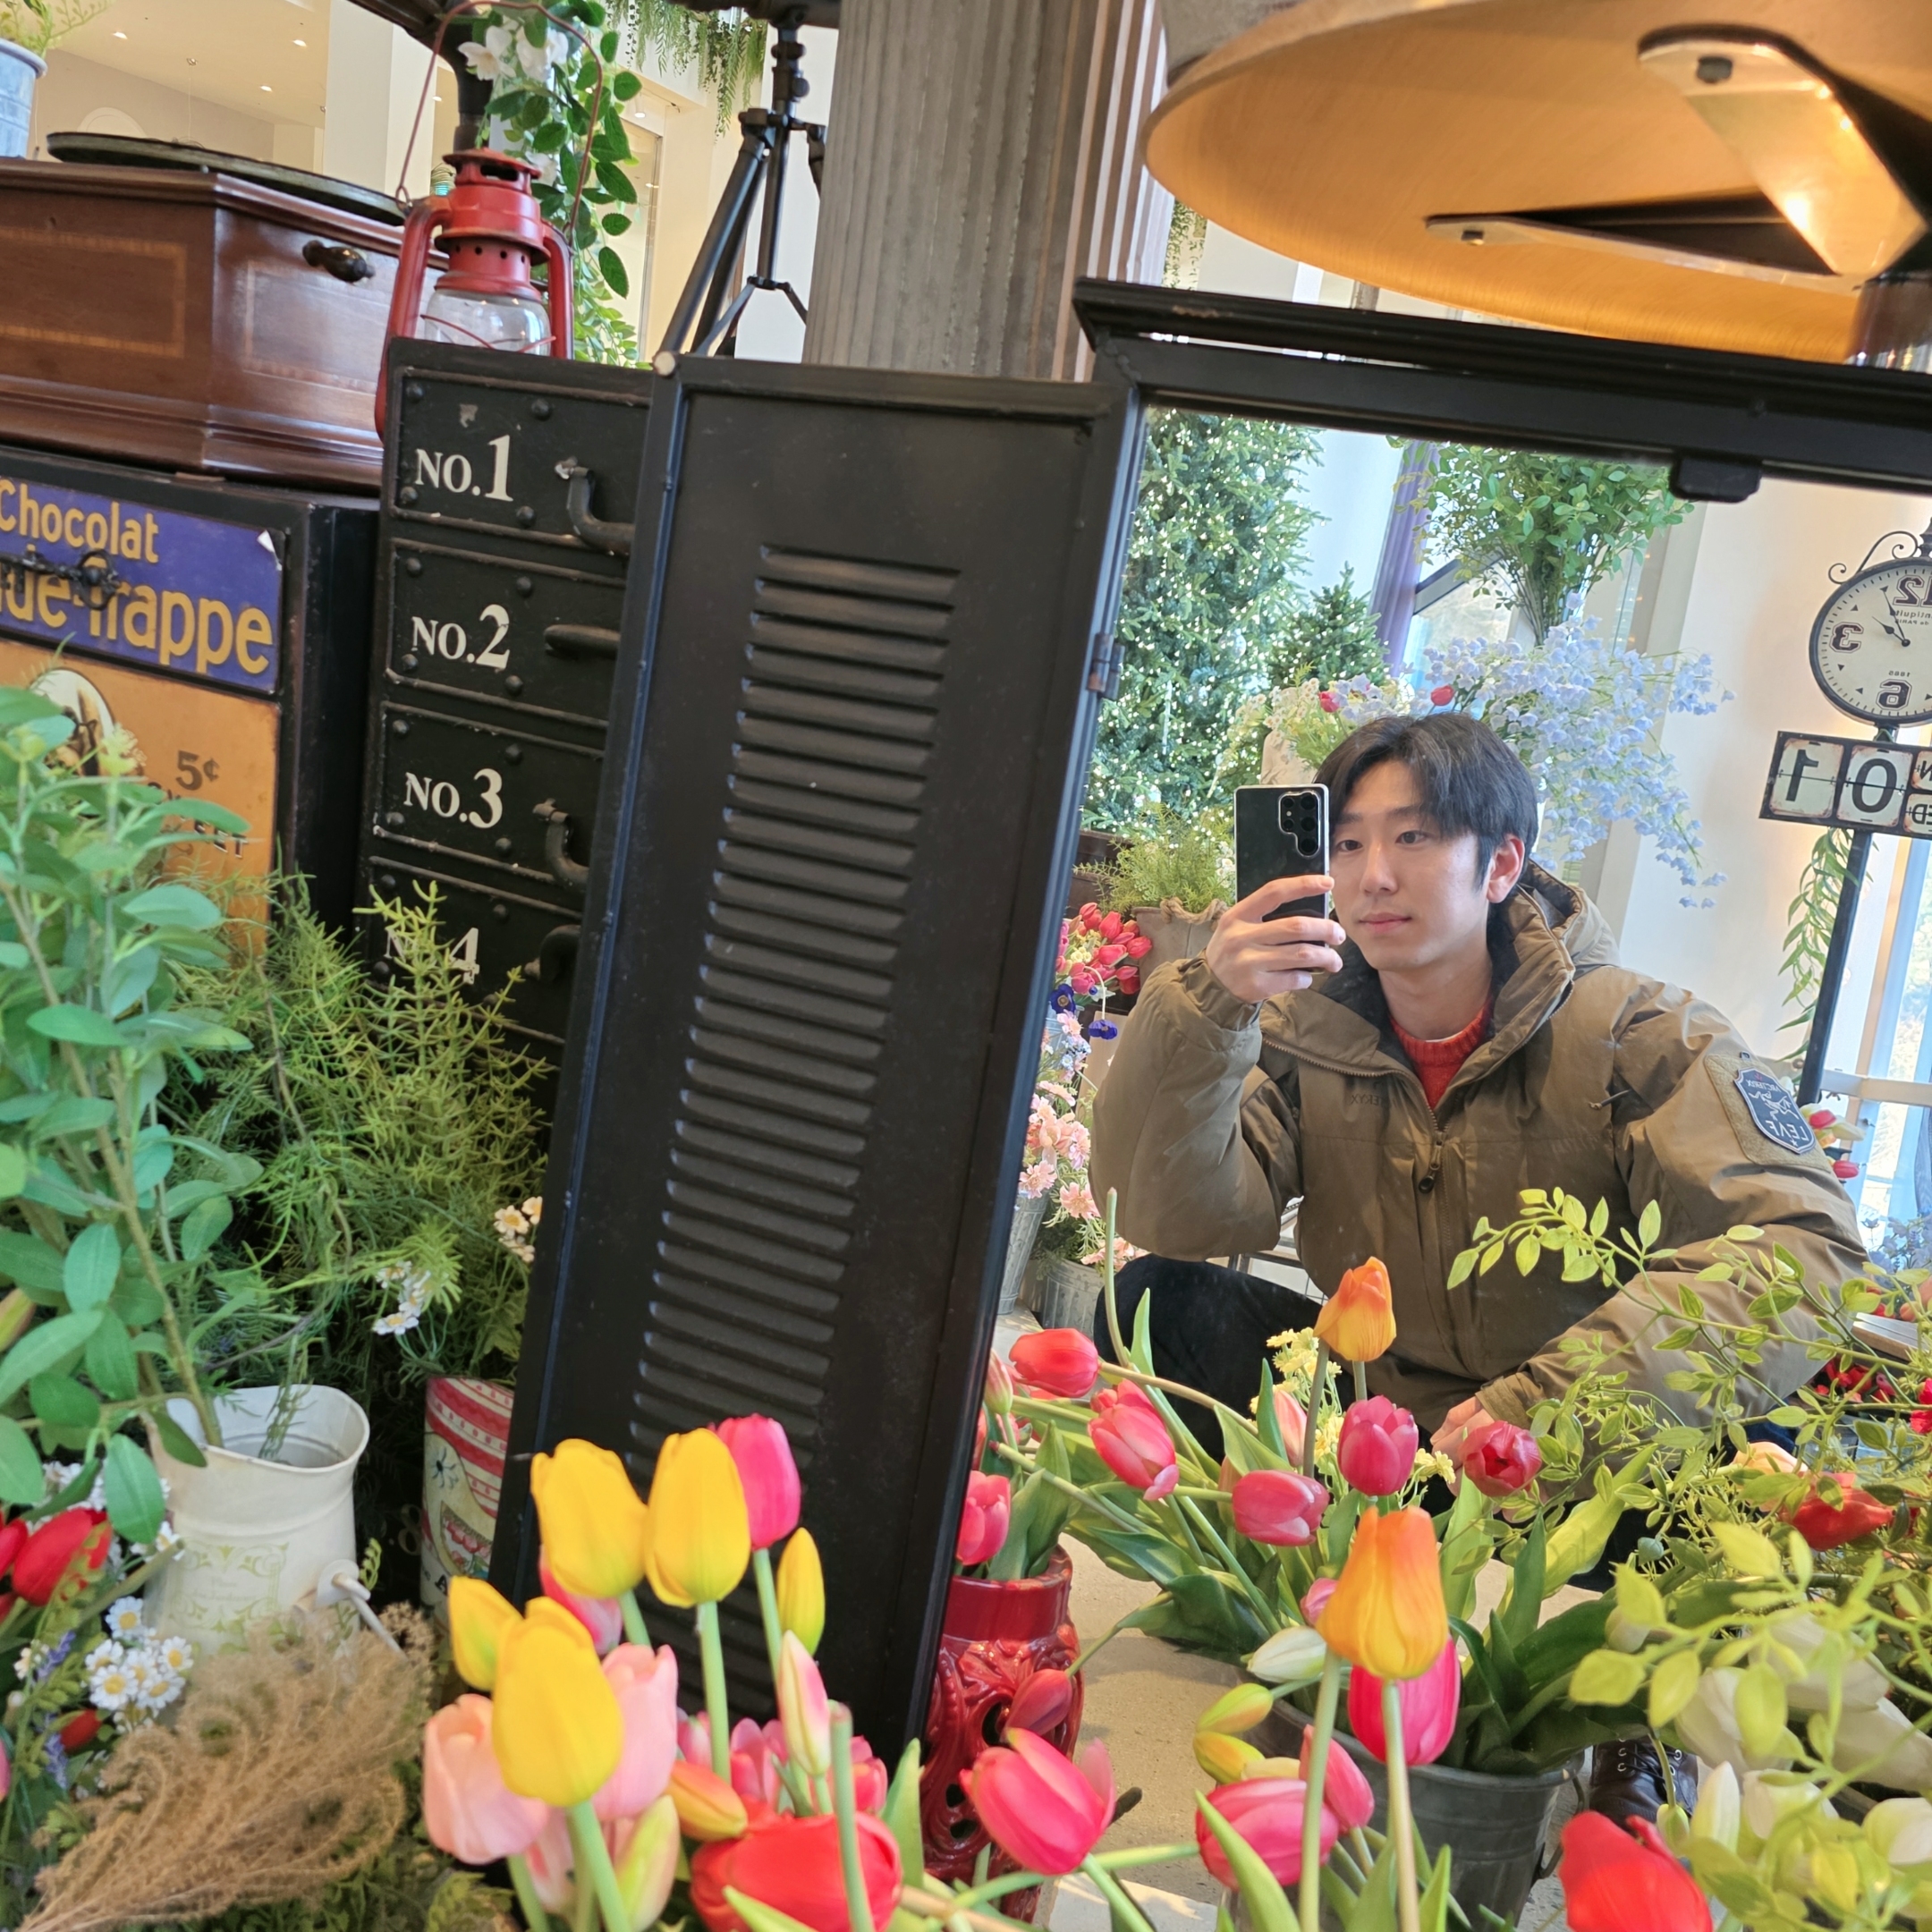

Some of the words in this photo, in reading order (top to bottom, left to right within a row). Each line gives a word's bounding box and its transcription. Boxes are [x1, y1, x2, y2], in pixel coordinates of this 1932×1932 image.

[415, 435, 513, 502] NO.1
[0, 478, 159, 564] Chocolat
[411, 604, 510, 670] NO.2
[175, 750, 220, 791] 5¢
[403, 768, 503, 829] NO.3
